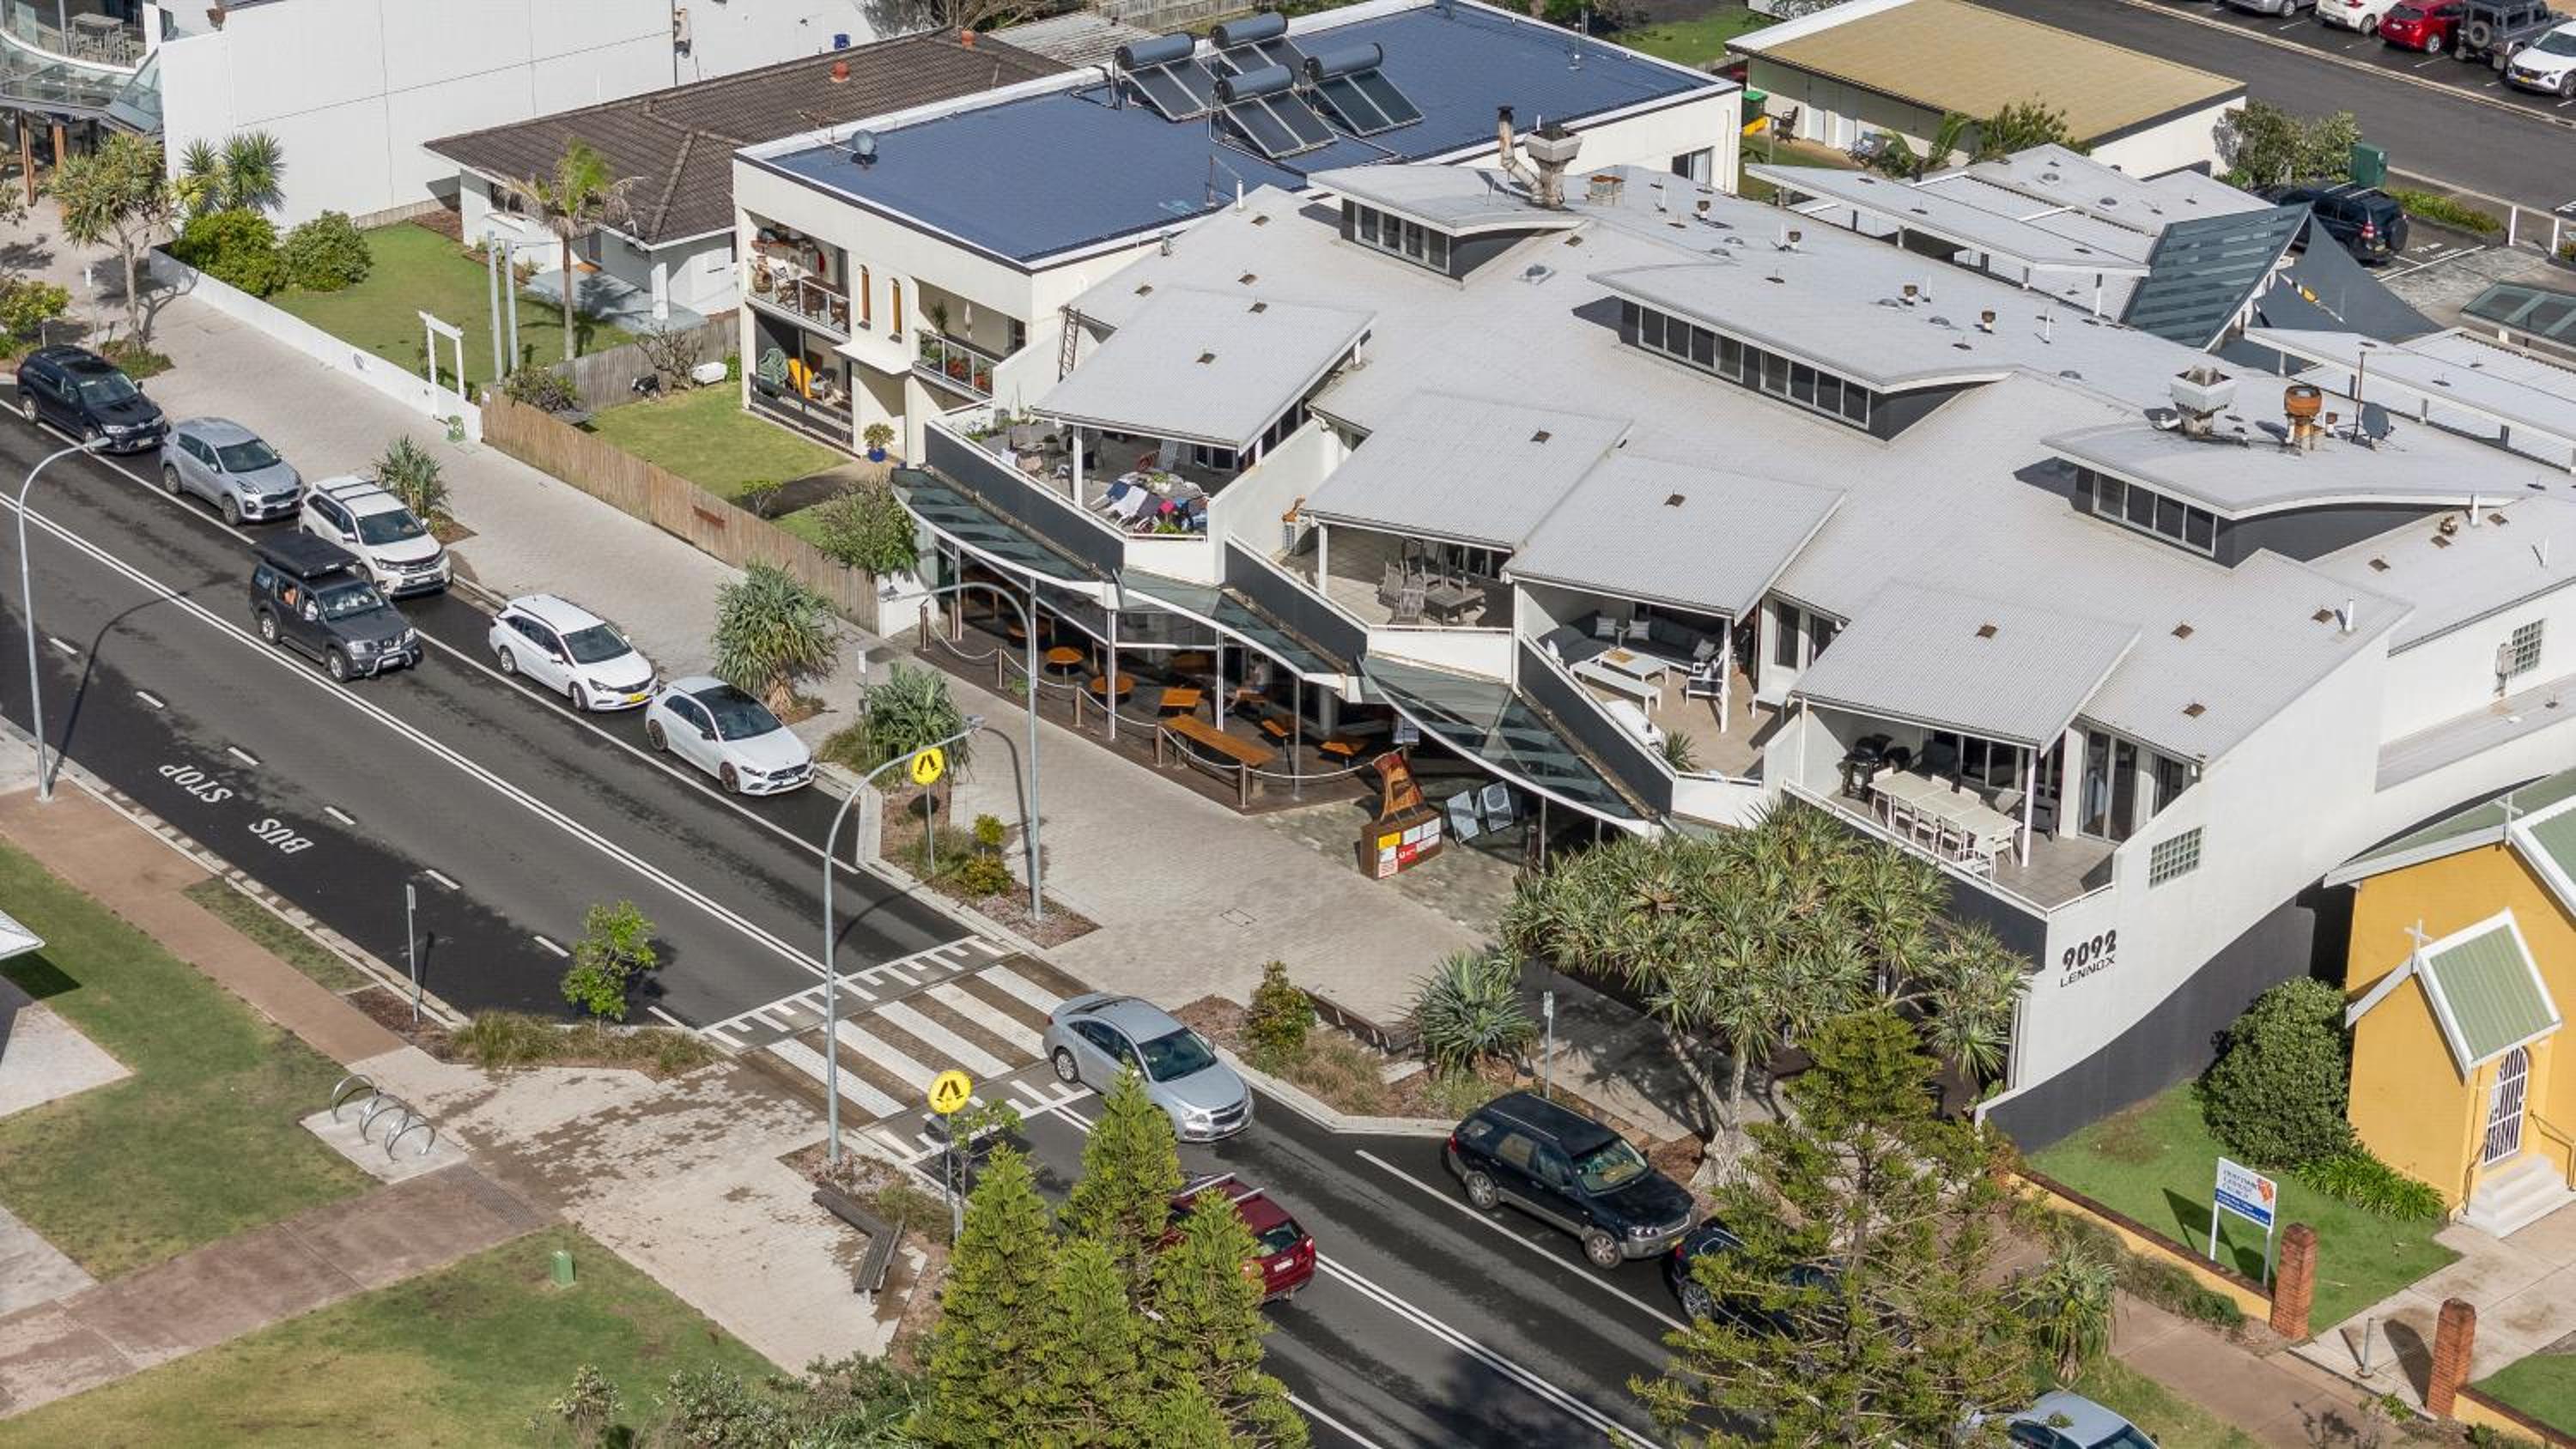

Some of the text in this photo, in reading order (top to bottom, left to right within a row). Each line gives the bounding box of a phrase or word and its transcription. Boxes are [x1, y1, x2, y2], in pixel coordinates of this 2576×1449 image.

[158, 764, 314, 854] BUS STOP
[2060, 955, 2115, 987] LENNOX
[2063, 930, 2116, 971] 9092
